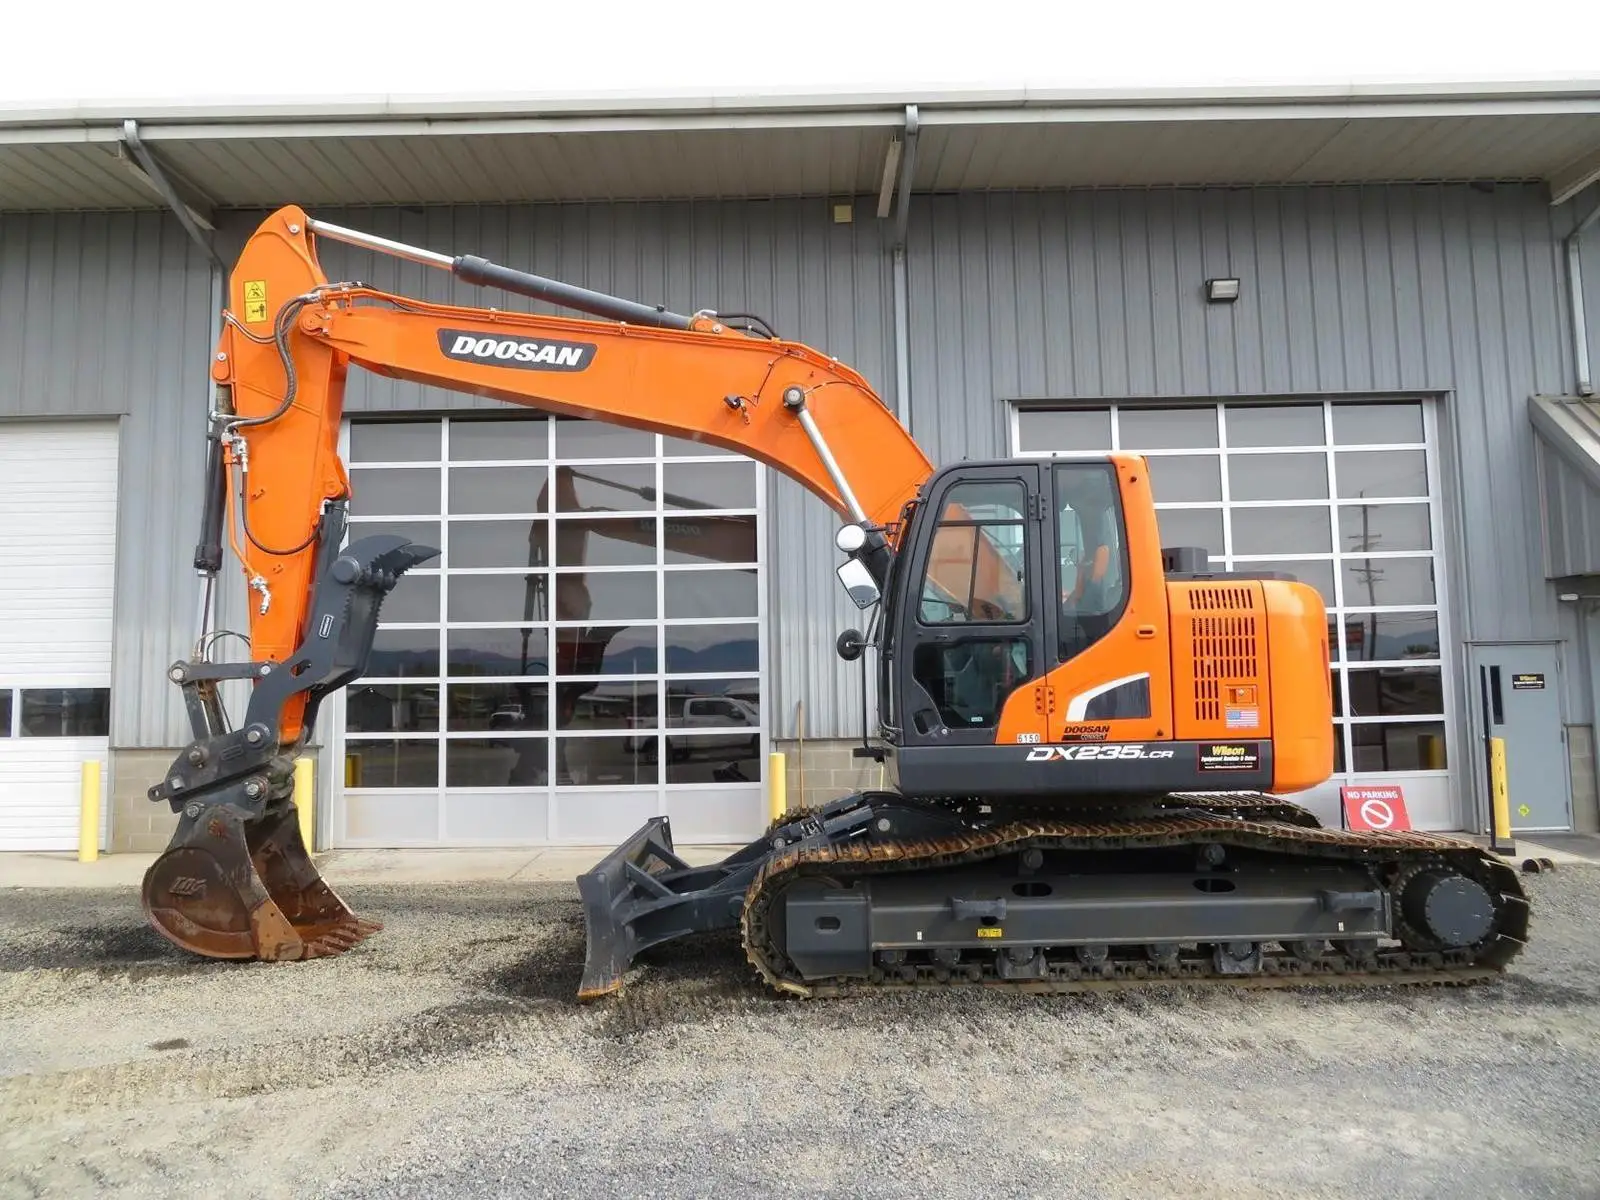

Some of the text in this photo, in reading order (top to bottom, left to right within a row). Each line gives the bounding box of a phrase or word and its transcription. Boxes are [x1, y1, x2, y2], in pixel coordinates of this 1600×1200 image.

[451, 336, 583, 366] DOOSAN
[1018, 734, 1039, 742] 6150
[1026, 745, 1174, 761] DX235LCR
[1212, 745, 1245, 756] Wilson
[1347, 790, 1398, 799] NO PARKING
